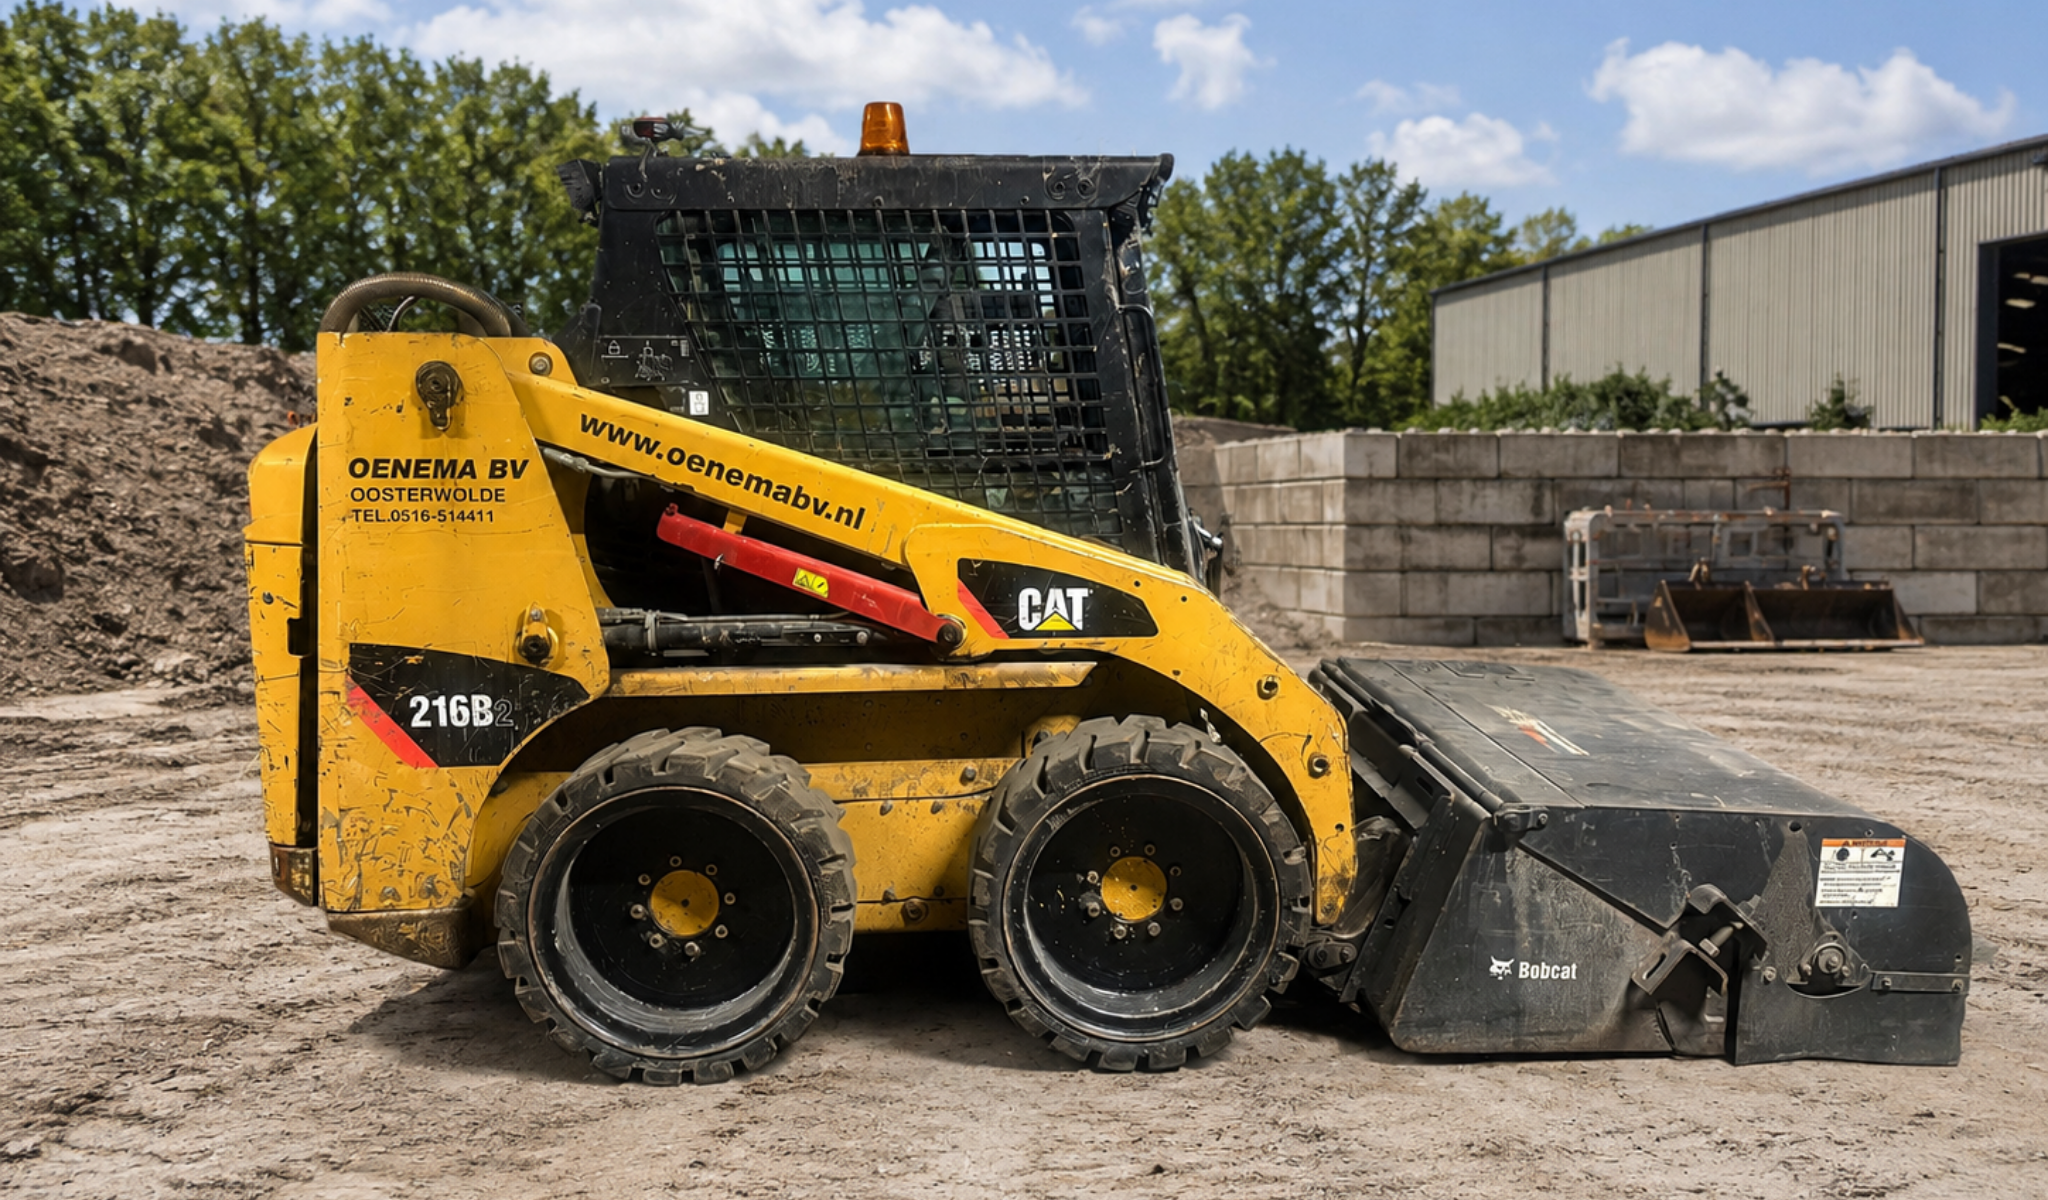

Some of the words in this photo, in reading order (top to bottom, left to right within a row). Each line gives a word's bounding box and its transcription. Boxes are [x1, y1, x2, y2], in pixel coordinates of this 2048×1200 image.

[348, 457, 477, 479] OENEMA
[488, 458, 530, 480] BV
[580, 413, 866, 530] www.oenemabv.nl
[350, 487, 506, 503] OOSTERWOLDE
[351, 509, 495, 523] TEL.0516-514411
[1018, 587, 1089, 631] CAT
[1518, 961, 1578, 980] Bobcat
